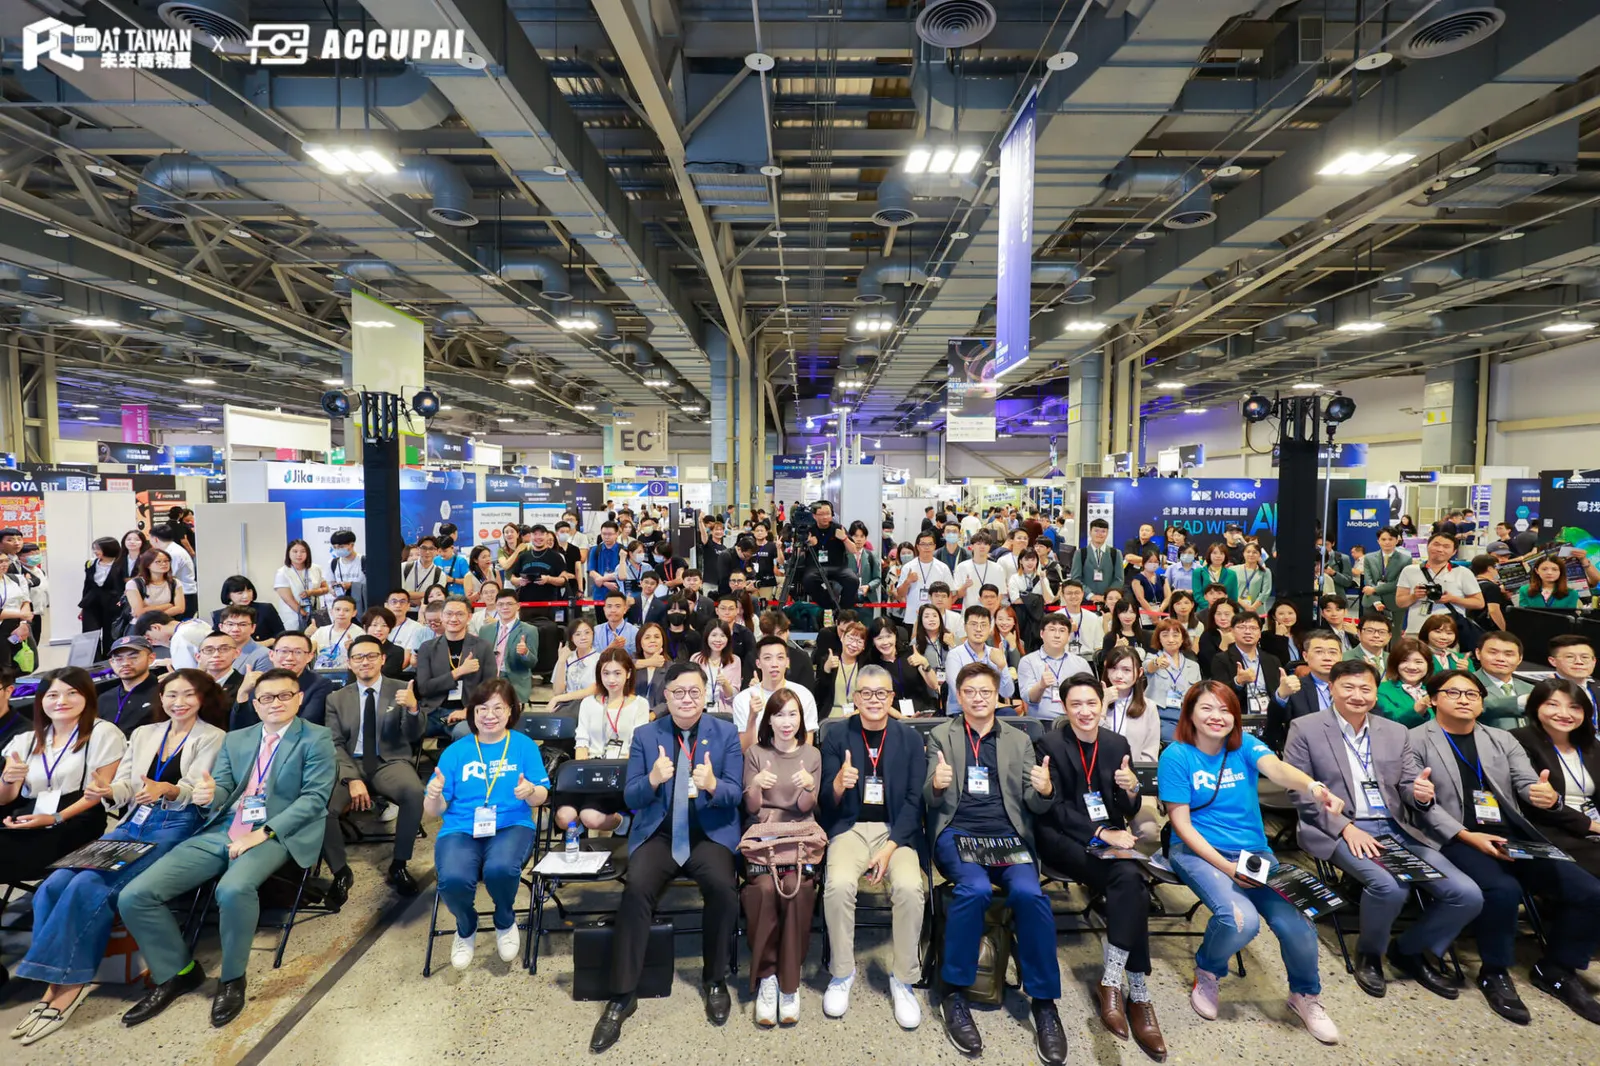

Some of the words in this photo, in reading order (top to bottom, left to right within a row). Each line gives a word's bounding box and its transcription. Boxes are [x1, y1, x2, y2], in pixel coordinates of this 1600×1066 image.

[621, 429, 653, 452] EC
[292, 470, 313, 483] Jika
[1, 481, 38, 492] HOYA
[41, 482, 60, 492] BIT
[1215, 491, 1256, 501] MoBagel
